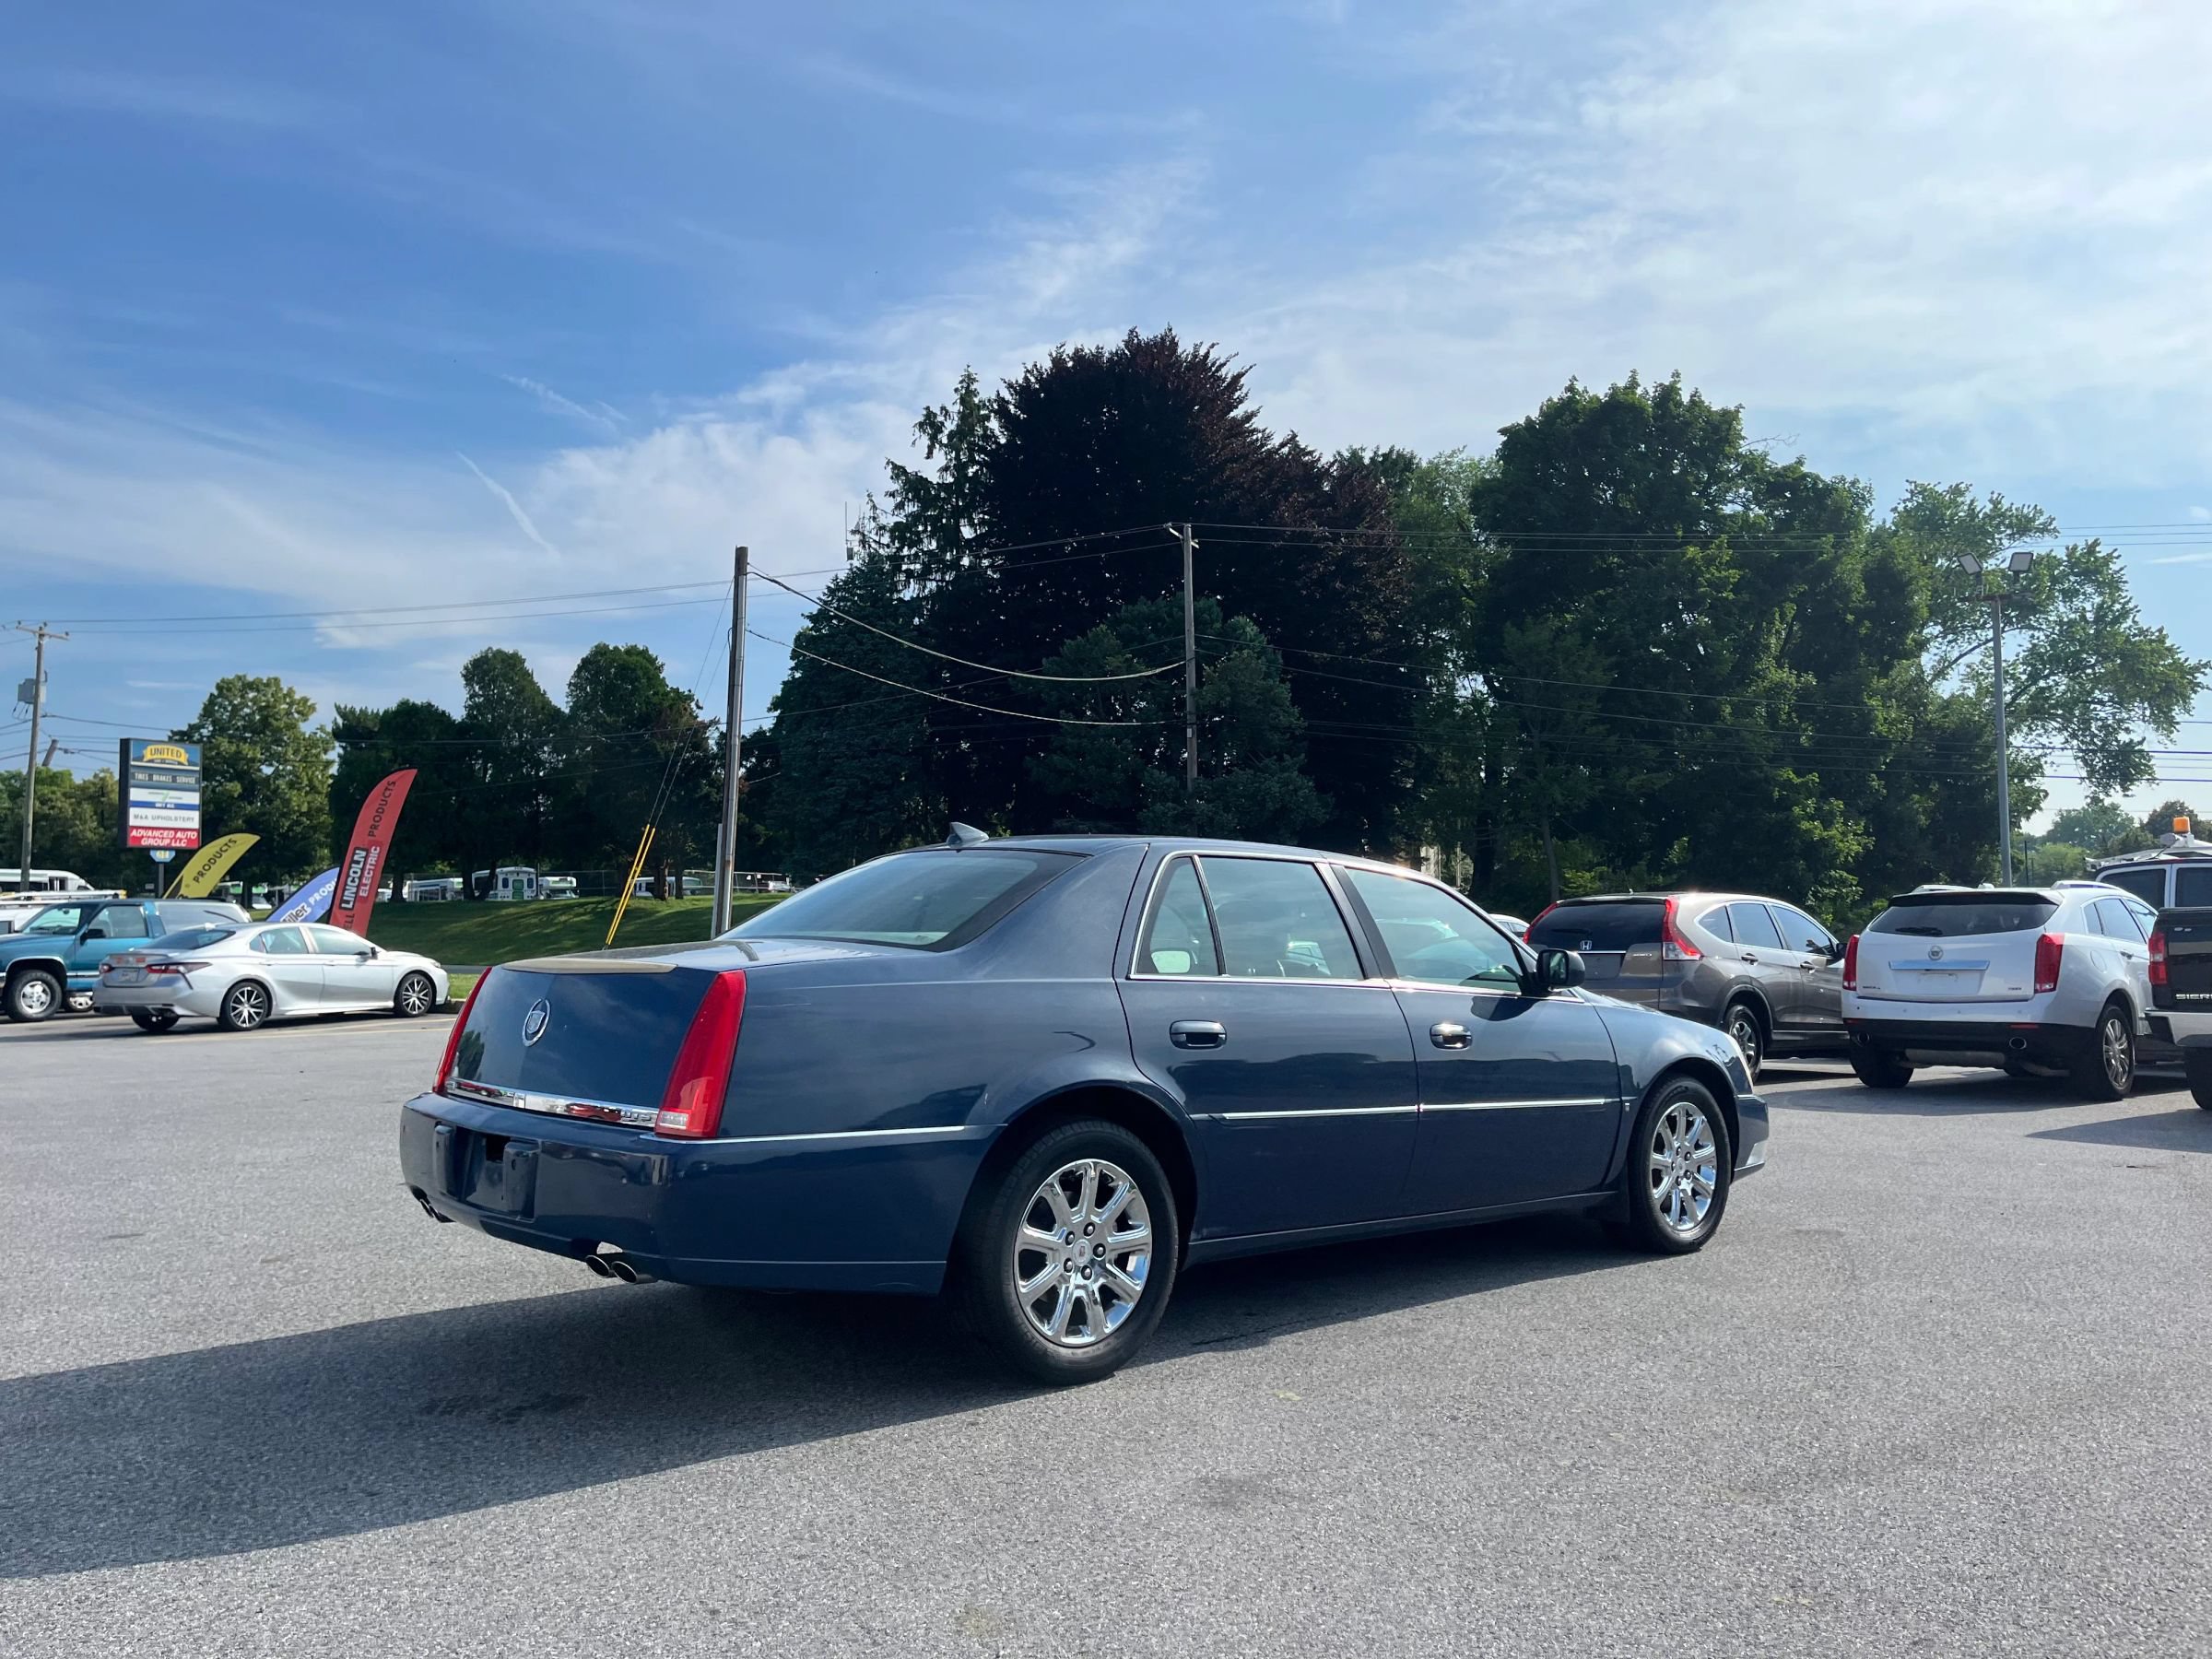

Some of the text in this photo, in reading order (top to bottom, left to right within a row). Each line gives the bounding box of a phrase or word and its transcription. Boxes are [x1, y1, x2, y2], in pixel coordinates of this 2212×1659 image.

[150, 747, 182, 758] UNITED
[152, 774, 172, 782] BRAKES
[176, 776, 195, 784] SERVICE
[368, 781, 396, 837] PRODUCTS
[131, 830, 197, 840] ADVANCED AUTO
[141, 838, 171, 846] GROUP
[193, 838, 237, 883] PRODUCTS
[359, 846, 380, 897] ELECTRIC
[341, 850, 367, 909] LINCOLN
[309, 878, 337, 906] PROD
[282, 905, 308, 923] iller
